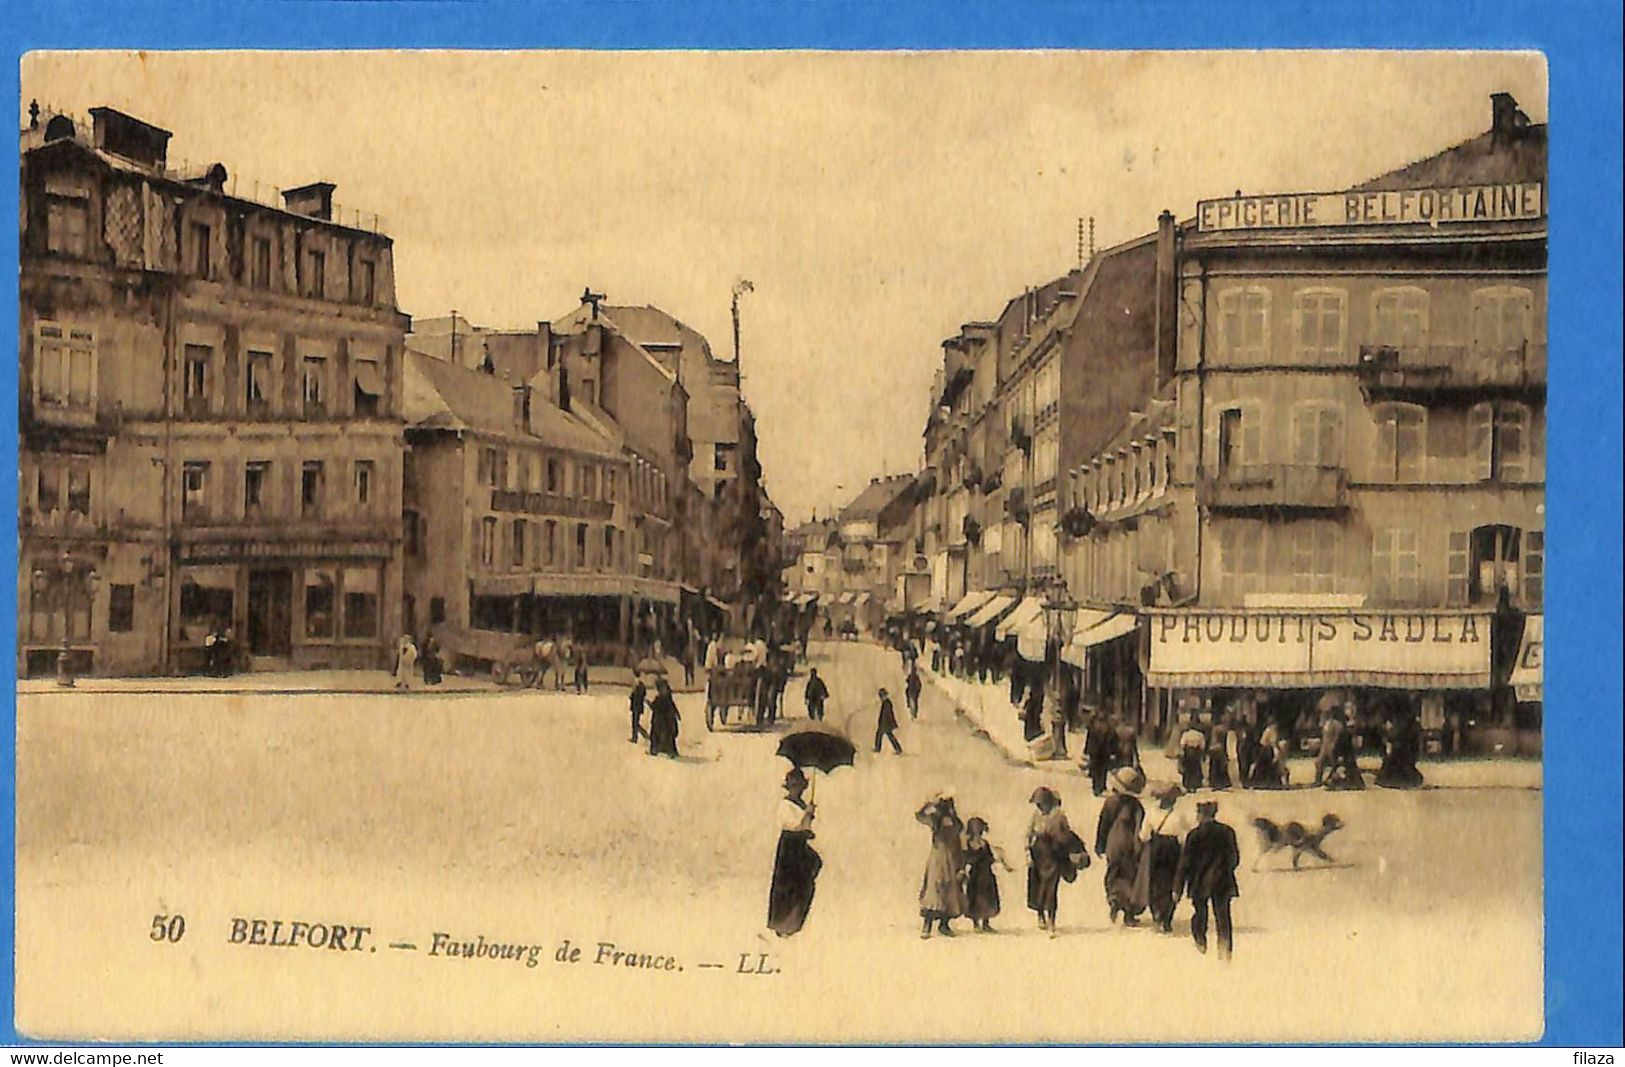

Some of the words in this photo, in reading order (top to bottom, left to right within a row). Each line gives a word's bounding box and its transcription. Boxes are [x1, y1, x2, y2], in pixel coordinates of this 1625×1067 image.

[1345, 183, 1537, 223] BELFORTAINE
[1159, 612, 1338, 643] PRODUITS
[1353, 613, 1479, 643] SADLA
